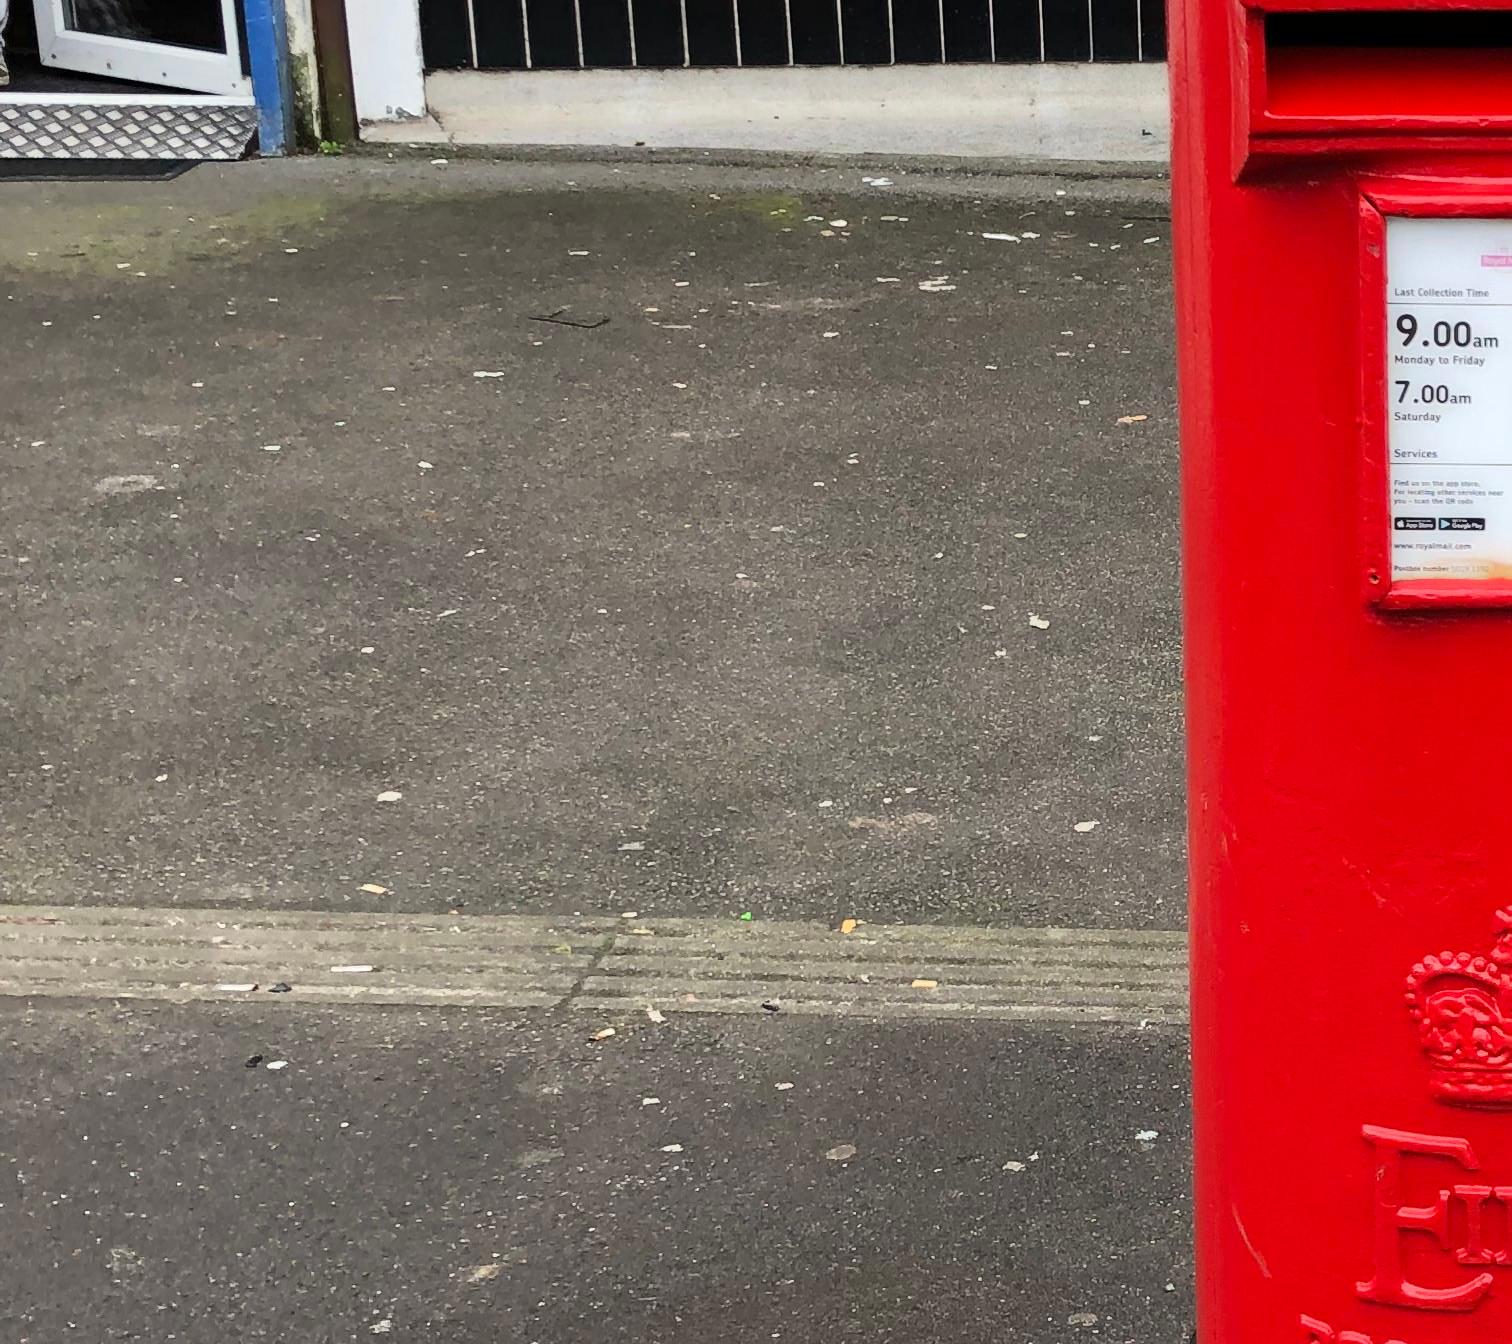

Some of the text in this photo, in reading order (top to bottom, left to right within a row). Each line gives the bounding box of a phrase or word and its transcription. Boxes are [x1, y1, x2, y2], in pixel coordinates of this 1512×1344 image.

[1394, 288, 1490, 297] Last Collection Time
[1396, 313, 1499, 348] 9.00am
[1394, 355, 1486, 367] Monday to Friday
[1395, 380, 1472, 404] 7.00am
[1394, 412, 1441, 423] Saturday
[1394, 448, 1438, 458] Services
[1452, 522, 1471, 530] Google
